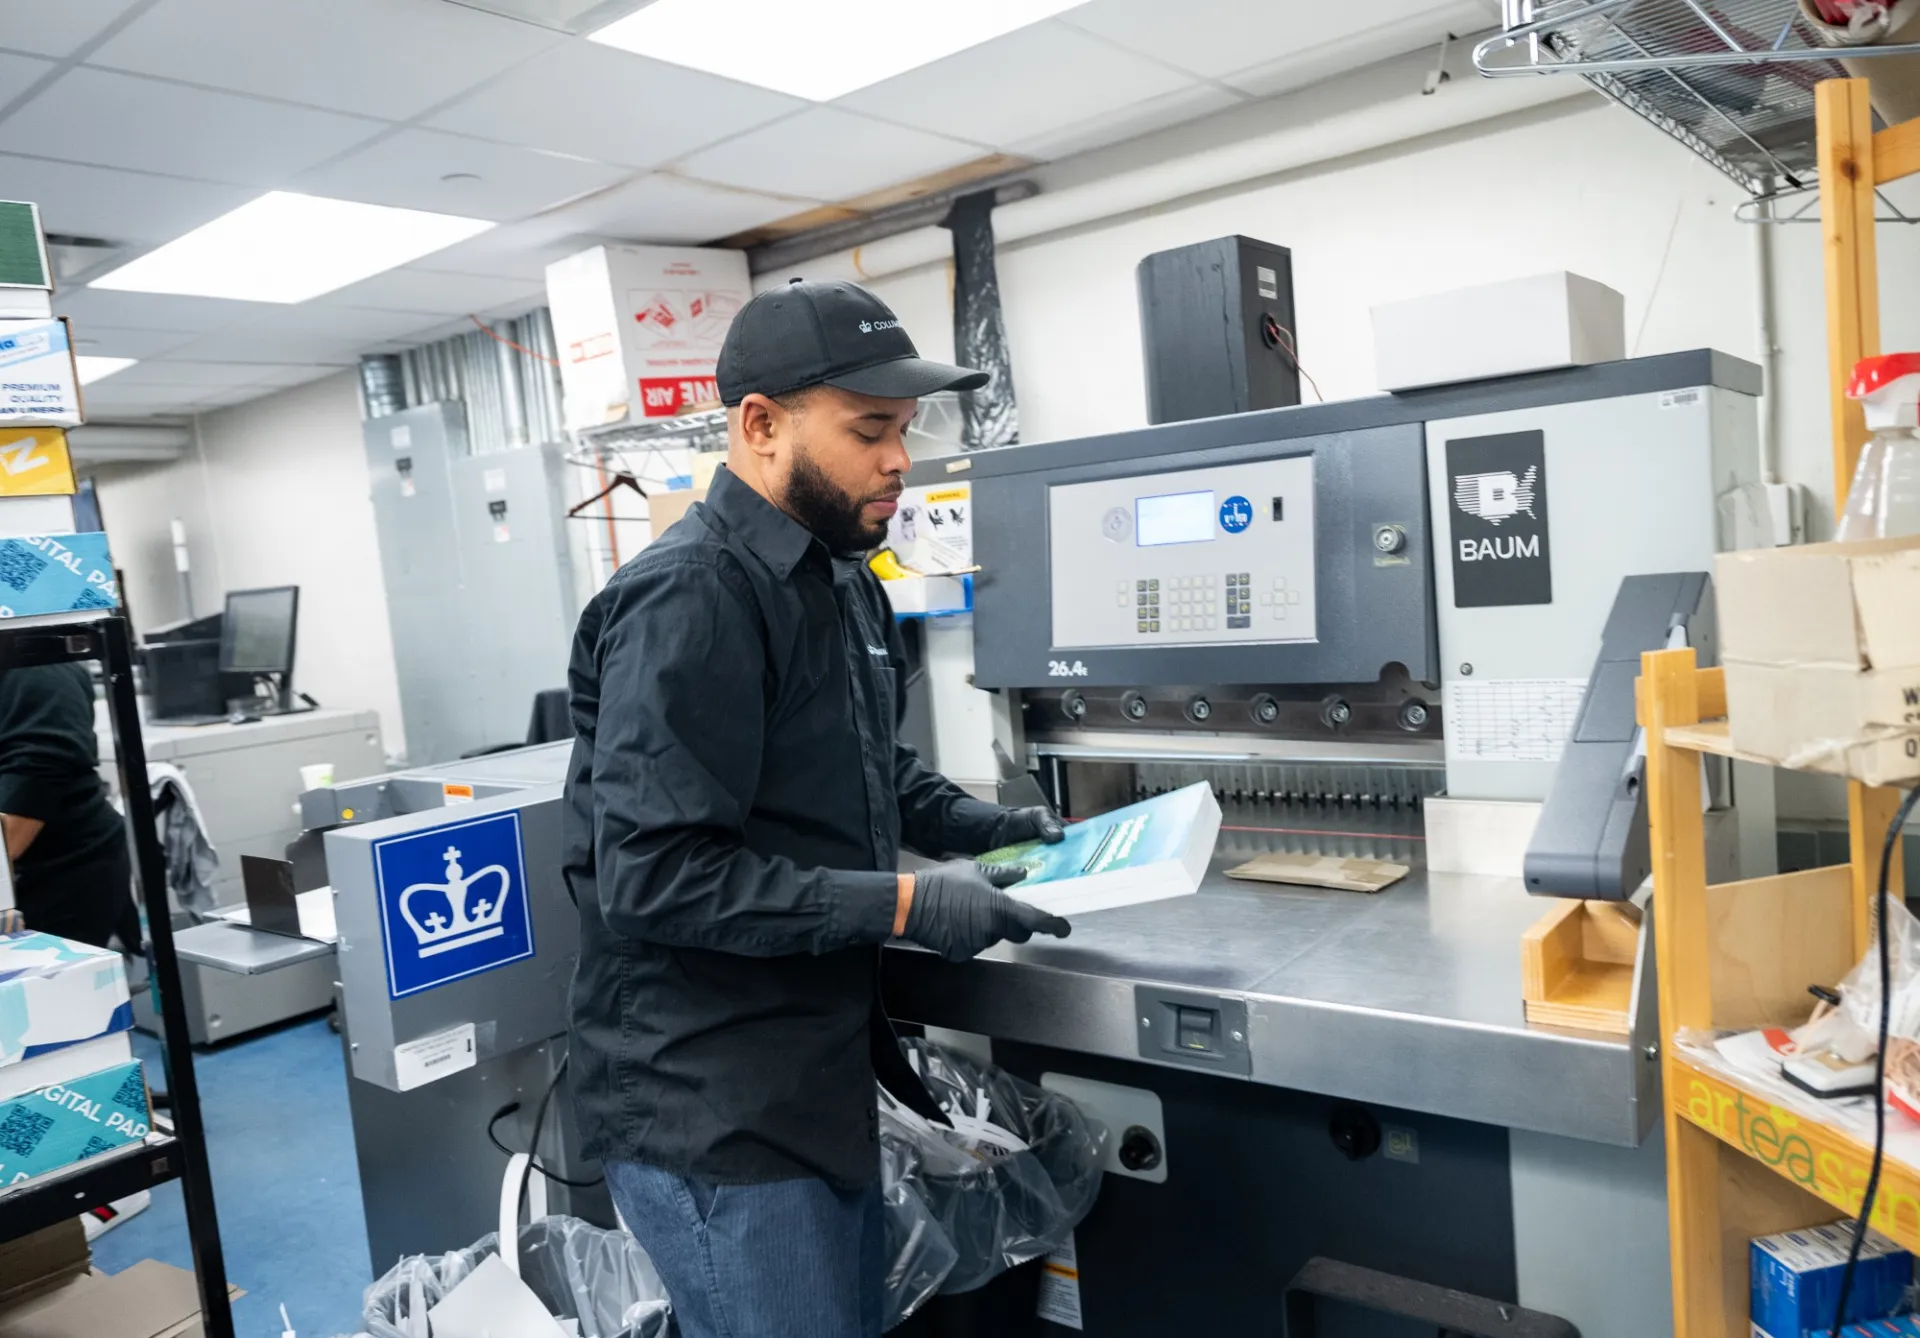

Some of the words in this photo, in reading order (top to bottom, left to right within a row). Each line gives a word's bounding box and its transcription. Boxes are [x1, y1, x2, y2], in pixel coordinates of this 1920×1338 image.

[2, 383, 61, 392] PREMIUM
[644, 386, 675, 406] AIR
[10, 394, 62, 403] QUALITY
[1459, 534, 1540, 562] BAUM
[35, 1084, 102, 1123] GITAL
